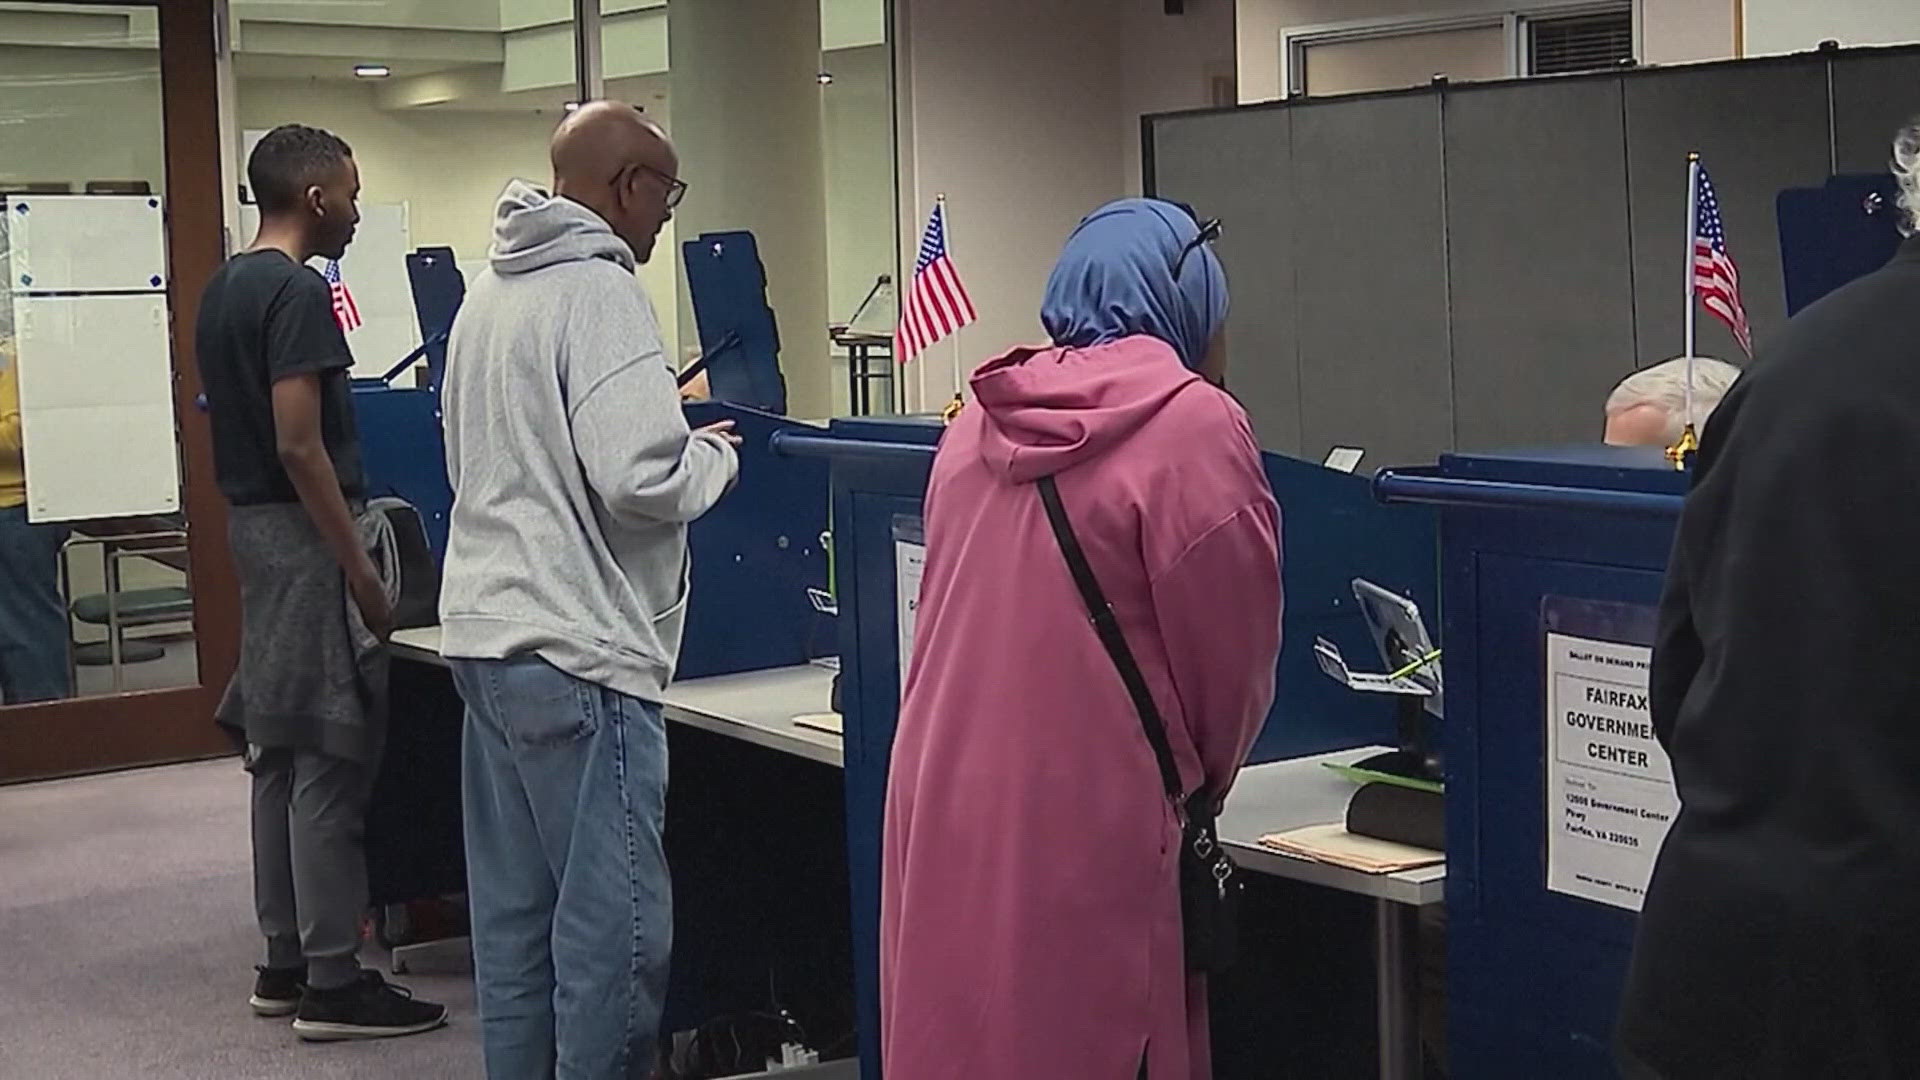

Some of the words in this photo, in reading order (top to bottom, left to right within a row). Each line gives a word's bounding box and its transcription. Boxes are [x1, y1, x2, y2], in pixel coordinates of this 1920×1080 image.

[1586, 687, 1648, 710] FAIRFAX
[1587, 743, 1648, 767] CENTER
[1640, 808, 1669, 822] Center
